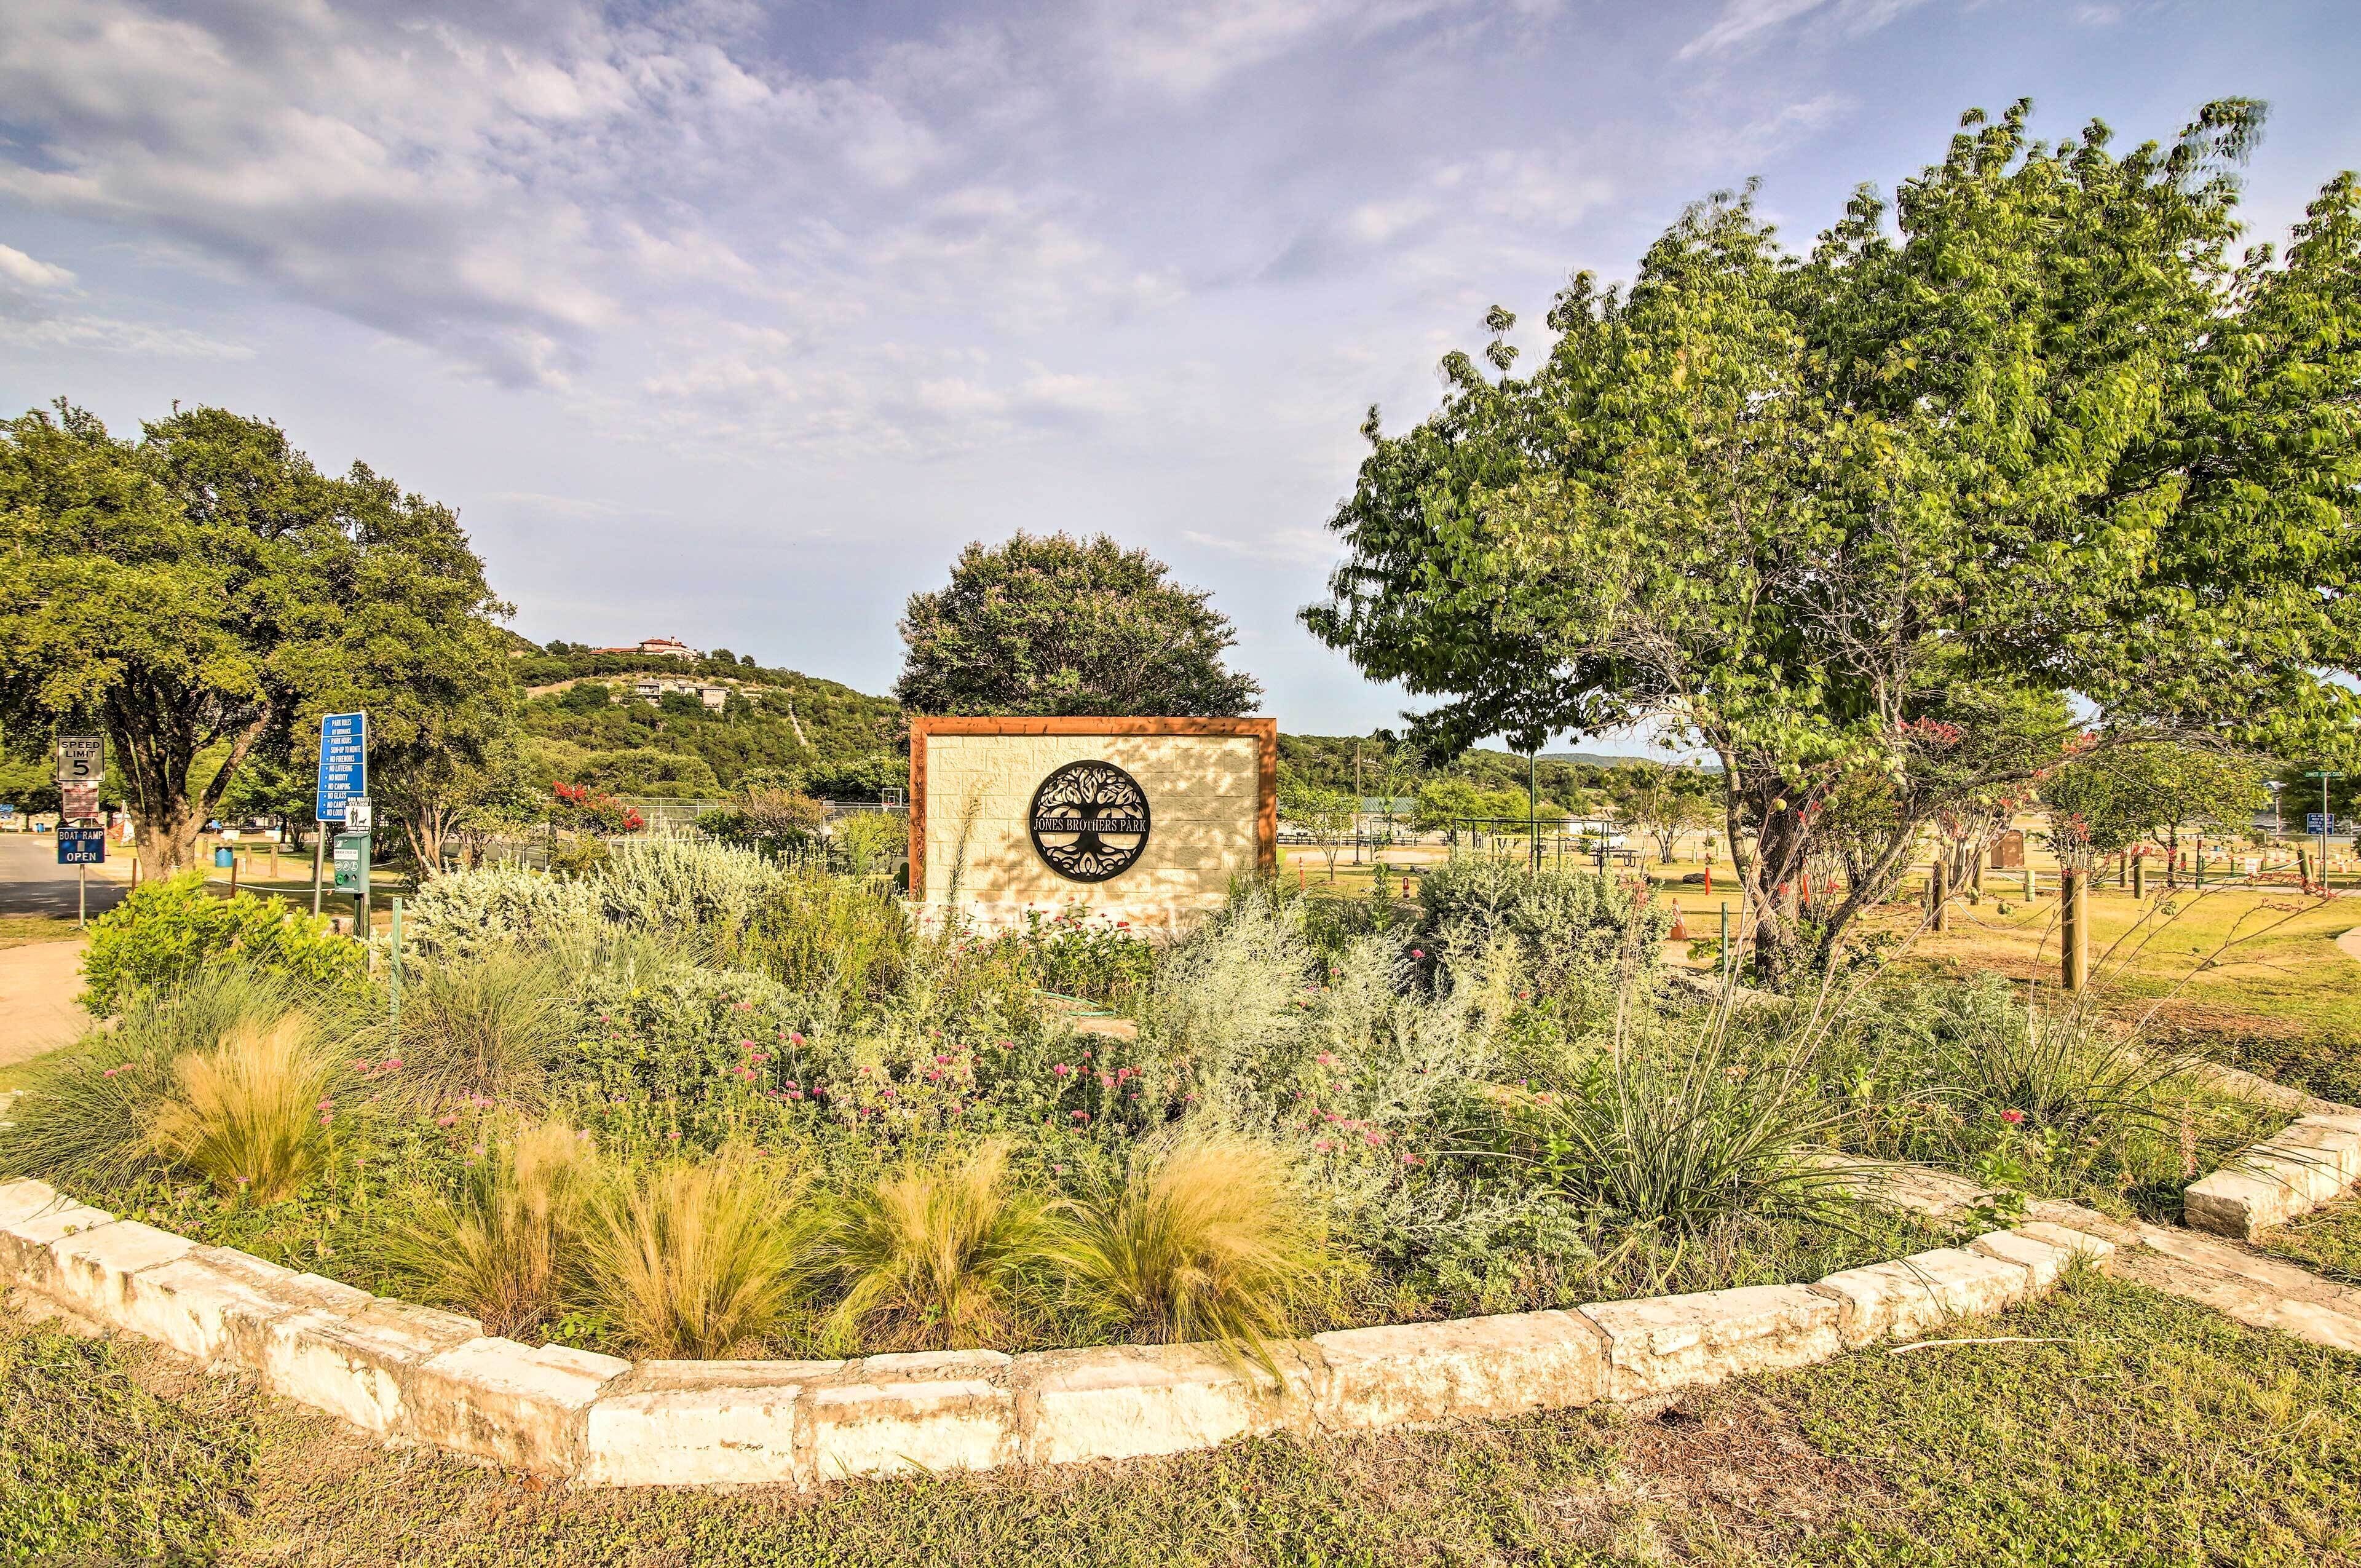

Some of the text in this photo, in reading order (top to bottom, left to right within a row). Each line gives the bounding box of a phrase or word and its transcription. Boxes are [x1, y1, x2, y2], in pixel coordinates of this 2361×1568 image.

[73, 759, 89, 775] 5
[1034, 818, 1146, 832] JONES BROTHERS PARK
[60, 831, 103, 840] BOAT RAMP
[66, 853, 96, 861] OPEN
